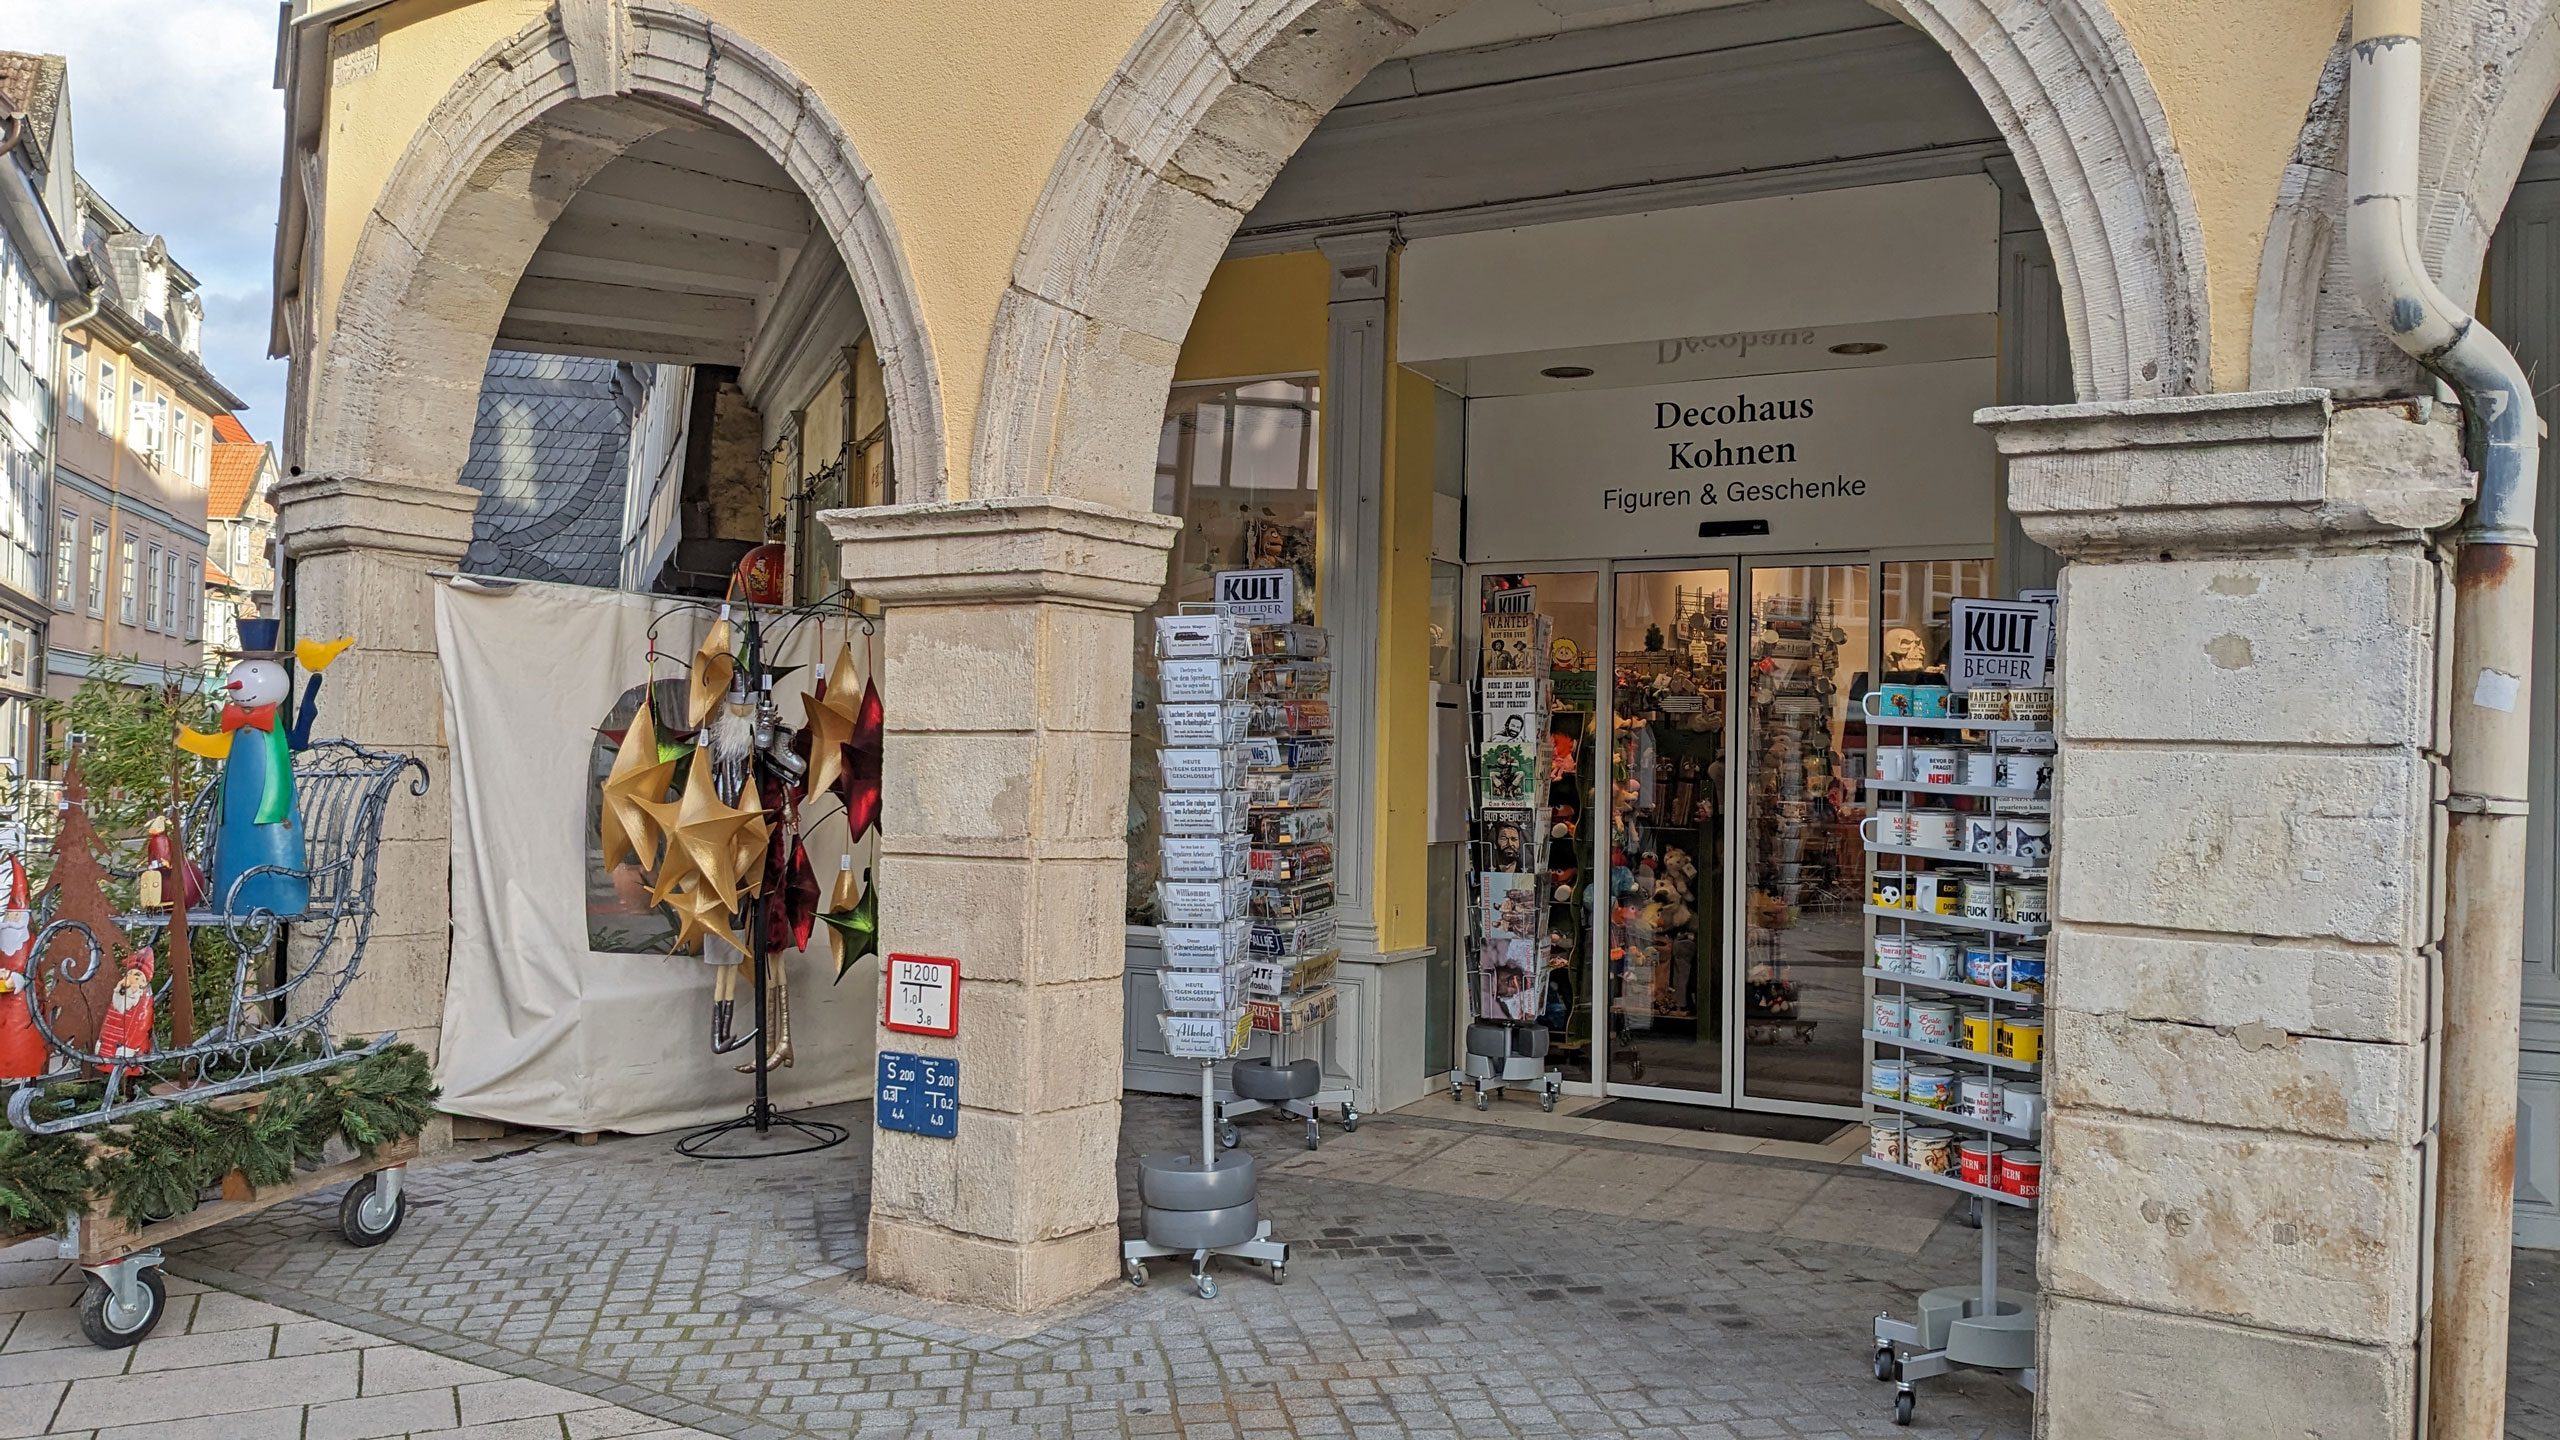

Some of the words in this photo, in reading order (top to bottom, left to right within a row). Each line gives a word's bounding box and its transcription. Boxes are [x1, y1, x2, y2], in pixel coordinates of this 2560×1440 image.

[1654, 394, 1814, 429] Decohaus
[1668, 438, 1797, 469] Kohnen
[1604, 488, 1691, 513] Figuren
[1700, 483, 1718, 505] &
[1727, 475, 1866, 502] Geschenke
[1223, 576, 1284, 601] KULT
[1229, 604, 1282, 615] CHILDER
[1488, 616, 1528, 629] WANTED
[1963, 611, 2038, 654] KULT
[1963, 658, 2032, 680] BECHER
[2012, 692, 2049, 703] WANTED
[2019, 714, 2048, 722] 20.000
[2034, 736, 2047, 744] Opa
[1251, 746, 1269, 763] Weg
[1928, 773, 1954, 784] NEIN!
[1484, 813, 1498, 822] BUD
[1500, 812, 1531, 822] SPENCER
[1250, 851, 1273, 871] BUD
[1175, 888, 1211, 897] Willkommen
[1966, 905, 1987, 918] FUCK
[2016, 911, 2042, 923] FUCK
[903, 963, 939, 983] H200
[1875, 1005, 1895, 1016] Beste
[1877, 1016, 1899, 1028] Oma
[1918, 1013, 1942, 1025] Beste
[1176, 1022, 1214, 1038] Alkohol
[1922, 1024, 1946, 1036] Oma
[887, 1062, 897, 1079] S
[899, 1069, 915, 1082] 200
[926, 1067, 936, 1085] S
[938, 1075, 955, 1087] 200
[1980, 1091, 1999, 1099] Ecte
[1976, 1099, 2002, 1107] Mäner
